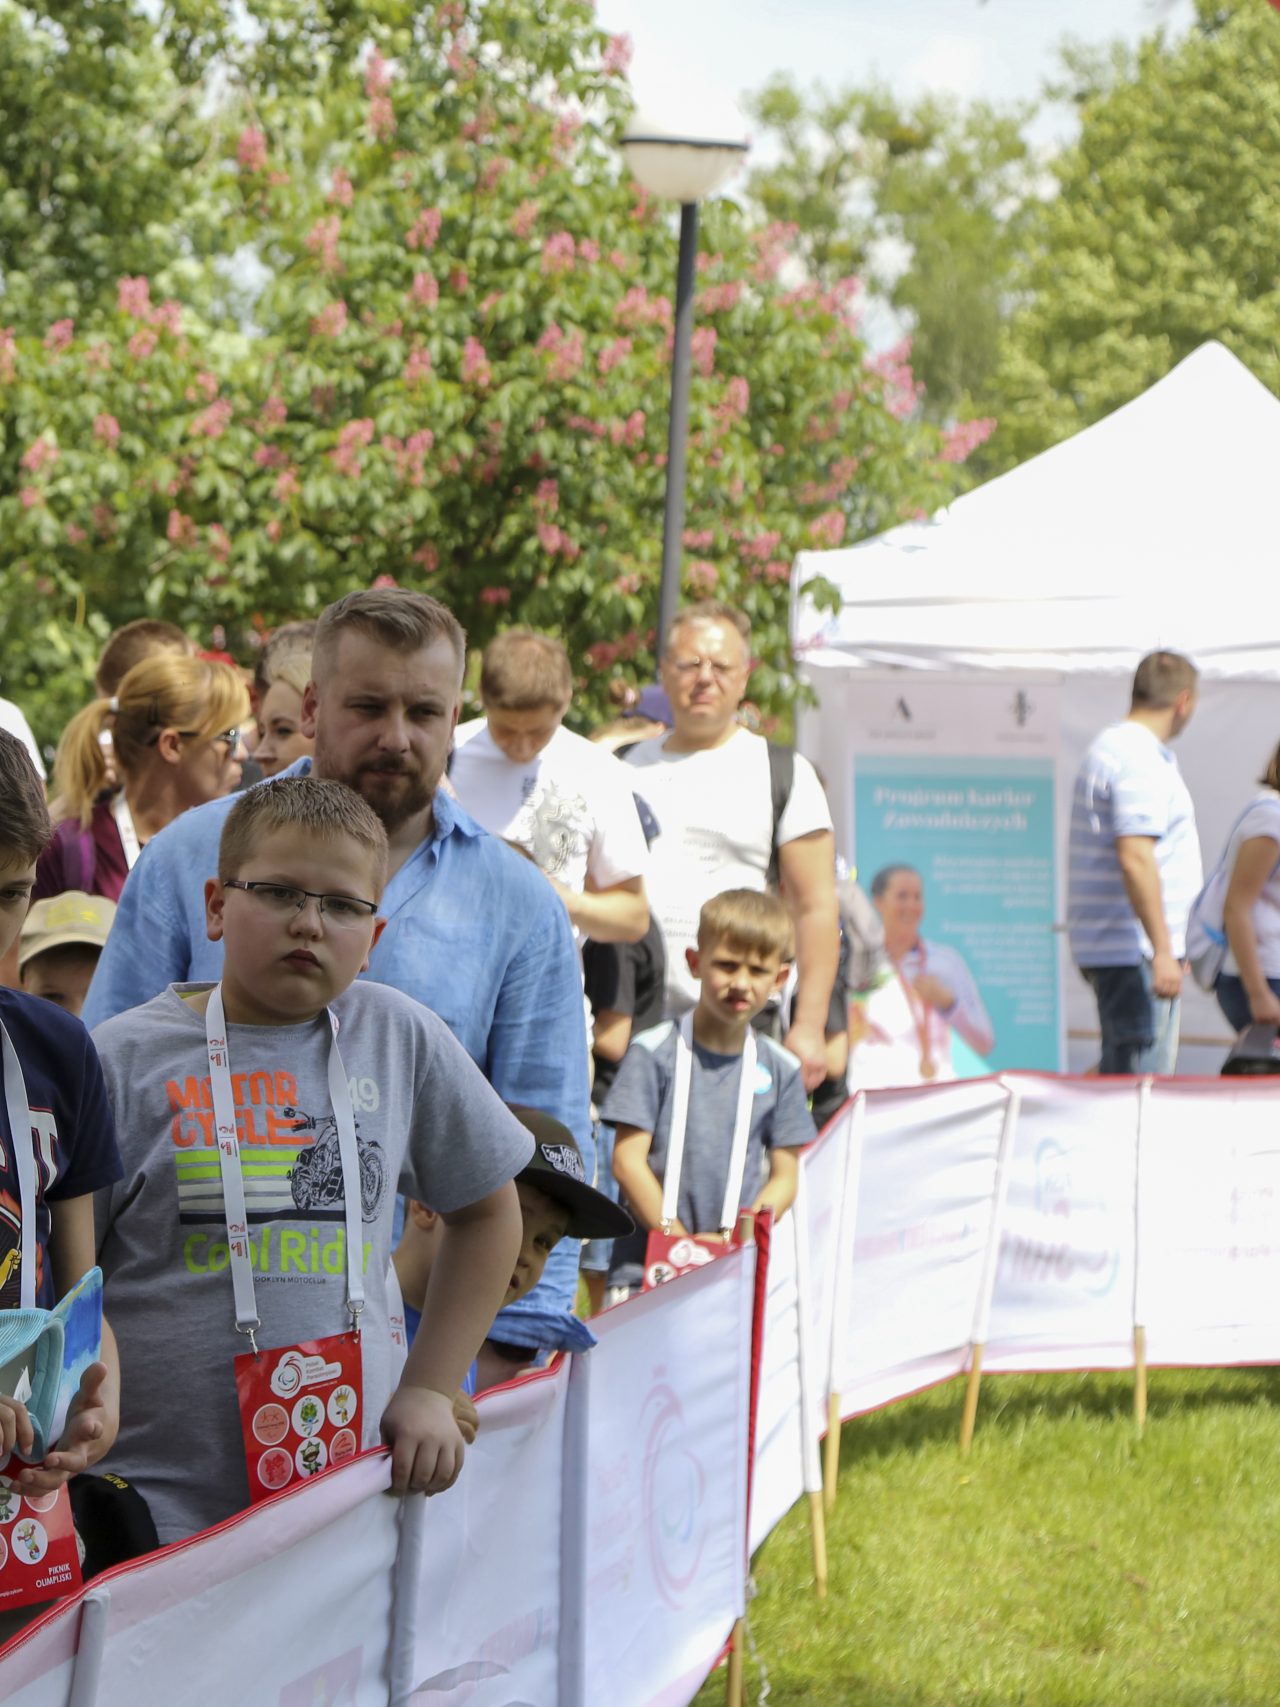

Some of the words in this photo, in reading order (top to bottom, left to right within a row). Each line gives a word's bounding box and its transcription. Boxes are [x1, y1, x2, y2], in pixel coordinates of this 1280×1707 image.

[164, 1070, 299, 1112] MOTOR
[279, 1227, 373, 1275] Ridr
[35, 1572, 73, 1588] OLIMPIJSKI
[48, 1563, 71, 1576] PIKNIK
